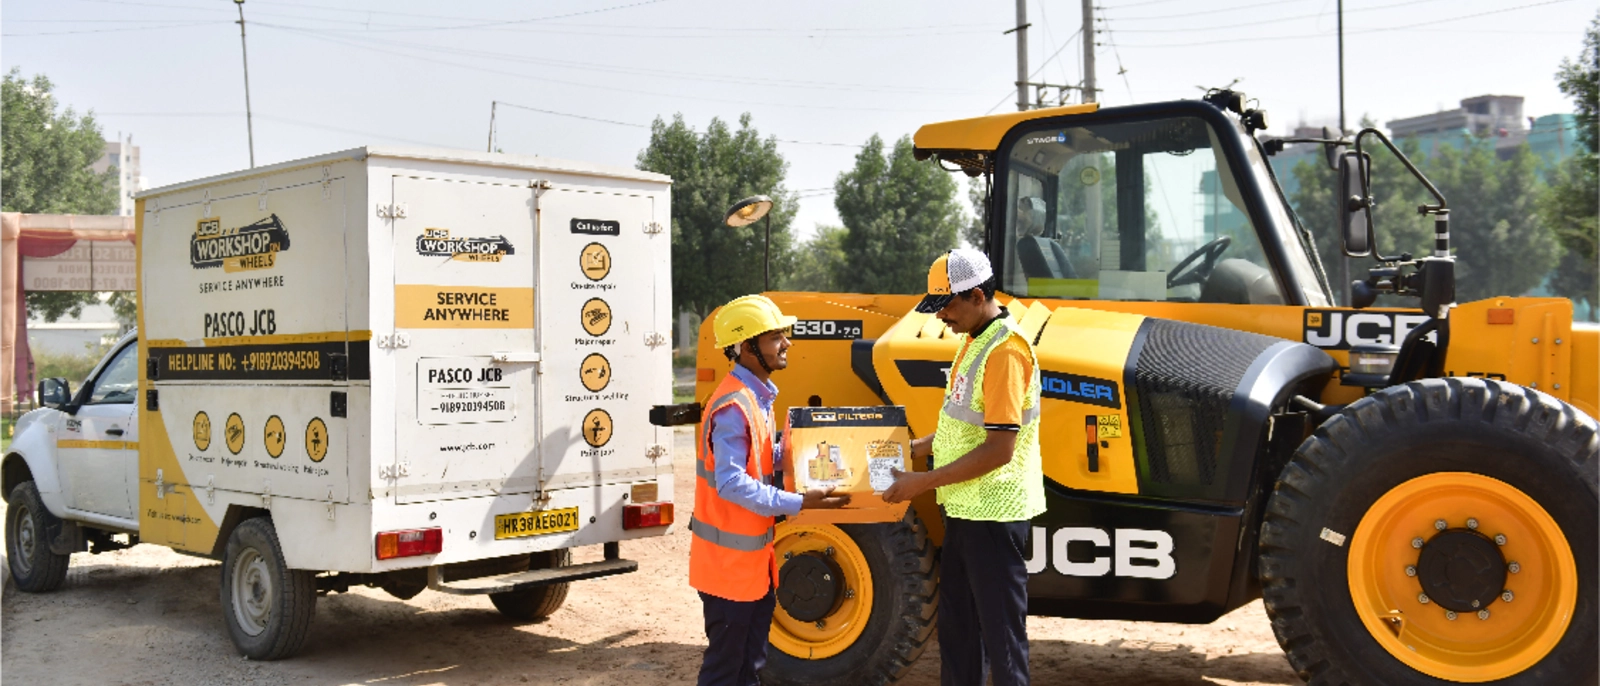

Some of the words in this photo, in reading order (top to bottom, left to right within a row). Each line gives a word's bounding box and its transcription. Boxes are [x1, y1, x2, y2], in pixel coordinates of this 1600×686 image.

[198, 221, 219, 236] JCB
[196, 232, 270, 260] WORKSHOP
[424, 240, 498, 254] WORKSHOP
[240, 254, 273, 269] WHEELS
[199, 280, 233, 293] SERVICE
[235, 275, 284, 291] ANYWHERE
[437, 292, 497, 306] SERVICE
[423, 308, 510, 322] ANYWHERE
[204, 311, 245, 338] PASCO
[249, 309, 277, 336] JCB
[168, 353, 214, 371] HELPLINE
[218, 352, 237, 370] NO:
[241, 350, 321, 371] +918920394508
[428, 368, 473, 383] PASCO
[477, 368, 502, 382] JCB
[837, 413, 883, 421] FILTERS
[503, 511, 577, 534] HR38AE6021
[1026, 526, 1176, 580] JCB
